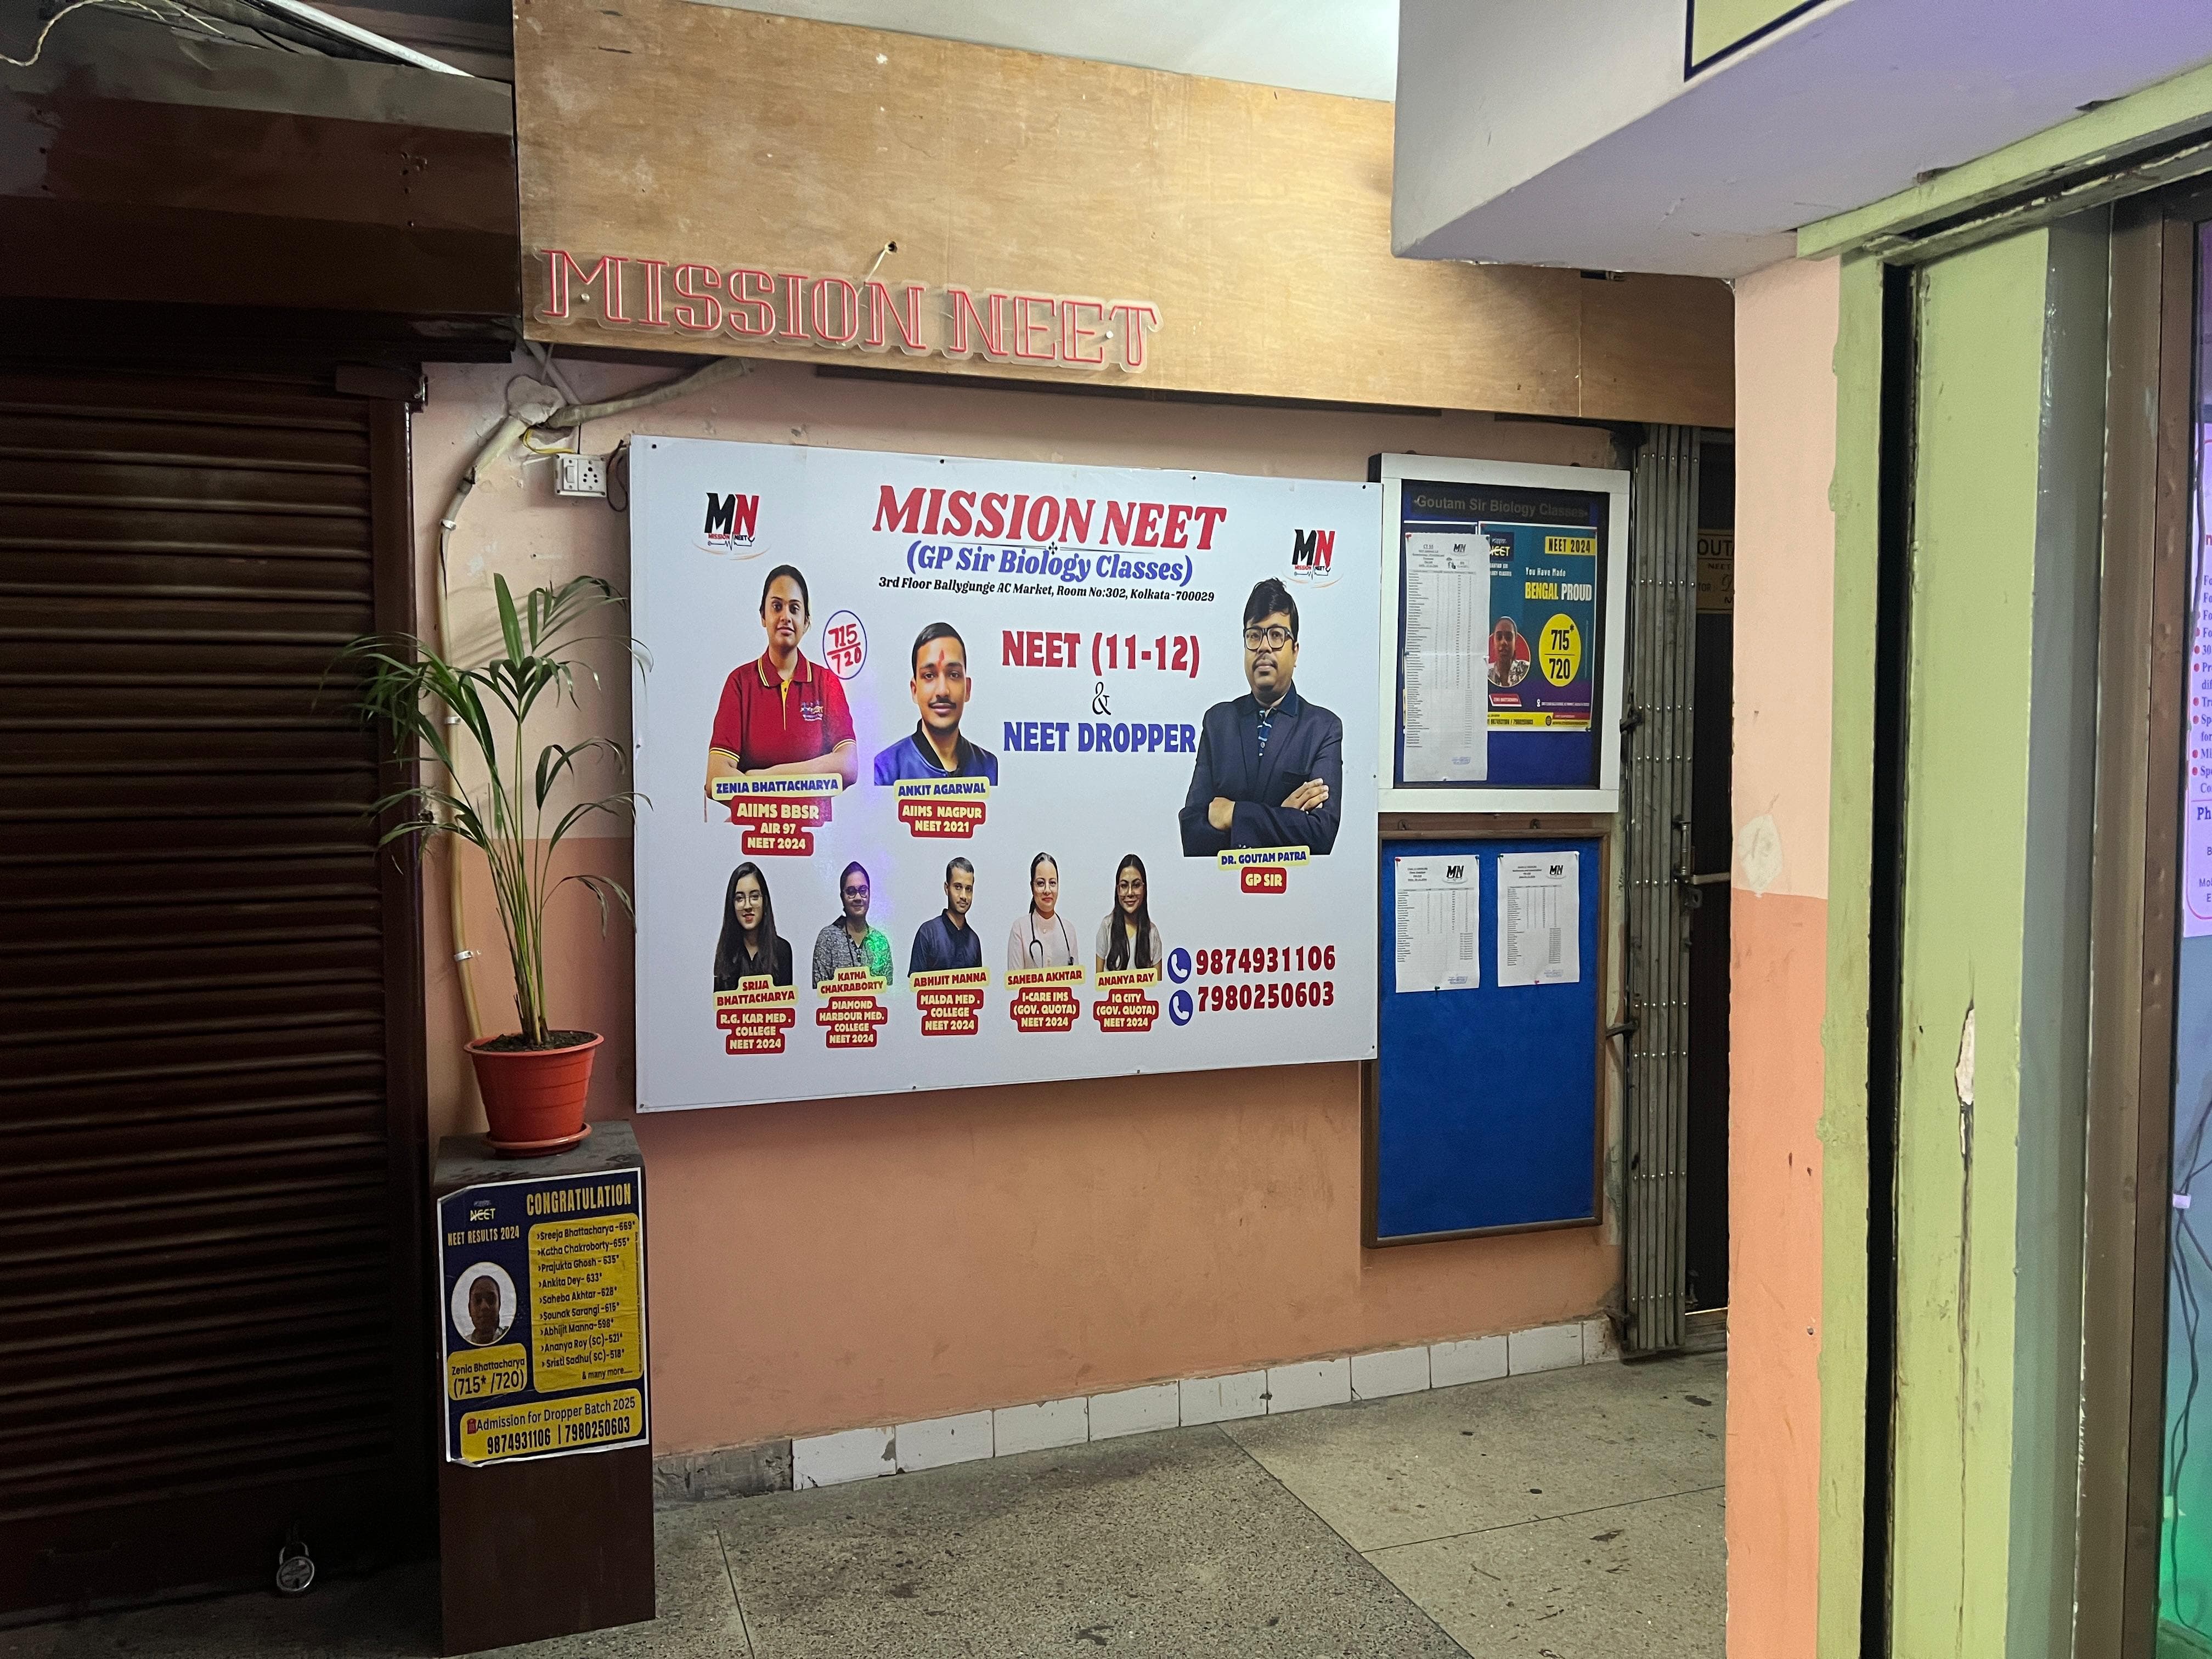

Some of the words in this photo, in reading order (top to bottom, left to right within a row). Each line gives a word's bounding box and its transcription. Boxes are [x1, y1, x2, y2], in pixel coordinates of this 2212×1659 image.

[541, 250, 926, 351] MISSION
[948, 291, 1156, 365] NEET
[1417, 495, 1465, 510] Goutam
[1469, 499, 1486, 511] Sir
[1490, 500, 1536, 517] Biology
[704, 492, 759, 538] MN
[873, 486, 1096, 543] MISSION
[1099, 502, 1227, 551] NEET
[1291, 529, 1335, 567] MN
[1549, 539, 1566, 552] NEET
[1571, 540, 1590, 553] 2024
[1697, 539, 1734, 555] OUT
[907, 540, 953, 574] (GP
[956, 546, 995, 571] Sir
[998, 549, 1091, 582] Biology
[1096, 554, 1192, 586] Classes)
[1537, 568, 1550, 576] Have
[878, 577, 900, 588] 3rd
[901, 578, 932, 589] Floor
[934, 579, 995, 595] Ballygunge
[997, 583, 1011, 593] AC
[1013, 583, 1054, 597] Market,
[1057, 585, 1086, 596] Room
[1088, 586, 1128, 600] No:302,
[1130, 589, 1214, 601] Kolkata-700029
[1525, 582, 1559, 600] BENGAL
[1561, 583, 1592, 601] PROUD
[827, 623, 856, 650] 715
[832, 647, 861, 674] 720
[1002, 630, 1081, 667] NEET
[1092, 633, 1200, 678] (11-12)
[1549, 659, 1570, 679] 720
[1092, 682, 1111, 715] &
[1004, 722, 1069, 751] NEET
[1078, 723, 1196, 753] DROPPER
[716, 780, 750, 794] ZENIA
[752, 778, 838, 793] BHATTACHARYA
[898, 786, 931, 797] ANKIT
[933, 782, 986, 795] AGARWAL
[737, 803, 777, 819] AIIMS
[780, 804, 819, 819] BBSR
[902, 805, 933, 817] AIIMS
[936, 806, 982, 819] NAGPUR
[760, 823, 781, 834] AIR
[782, 823, 795, 834] 97
[915, 821, 940, 832] NEET
[943, 821, 970, 833] 2021
[747, 838, 776, 849] NEET
[777, 838, 805, 850] 2024
[1221, 855, 1237, 865] DR.
[1238, 853, 1276, 864] GOUTAM
[1278, 851, 1306, 861] PATRA
[1446, 866, 1464, 878] MN
[1549, 865, 1563, 875] MN
[1245, 873, 1262, 887] GP
[1263, 874, 1283, 887] SIR
[1196, 945, 1336, 975] 9874931106
[838, 971, 866, 981] KATHA
[913, 975, 949, 987] ABHIJIT
[952, 972, 986, 984] MANNA
[1007, 974, 1043, 985] SAHEBA
[1046, 970, 1082, 983] AKHTAR
[1098, 975, 1135, 986] ANANYA
[1137, 973, 1154, 984] RAY
[742, 980, 769, 991] SRIJA
[821, 981, 883, 994] CHAKRABORTY
[717, 991, 795, 1006] BHATTACHARYA
[921, 995, 952, 1005] MALDA
[1023, 992, 1051, 1002] I-CARE
[1052, 992, 1068, 1002] IMS
[1112, 994, 1122, 1003] IQ
[1124, 993, 1142, 1003] CITY
[1198, 981, 1334, 1012] 7980250603
[832, 1001, 873, 1010] DIAMOND
[931, 1007, 969, 1018] COLLEGE
[1014, 1005, 1040, 1015] (GOV.
[1041, 1005, 1076, 1015] QUOTA)
[1097, 1006, 1120, 1016] (GOV.
[1122, 1005, 1156, 1015] QUOTA)
[720, 1014, 740, 1024] R.G.
[742, 1014, 764, 1023] KAR
[820, 1012, 862, 1021] HARBOUR
[864, 1011, 884, 1020] MED.
[1021, 1017, 1043, 1027] NEET
[1045, 1017, 1068, 1027] 2024
[1103, 1018, 1125, 1028] NEET
[1126, 1018, 1148, 1027] 2024
[736, 1026, 776, 1036] COLLEGE
[834, 1023, 869, 1031] COLLEGE
[925, 1020, 949, 1030] NEET
[950, 1019, 974, 1030] 2024
[730, 1040, 754, 1049] NEET
[757, 1039, 781, 1048] 2024
[830, 1035, 851, 1043] NEET
[853, 1034, 873, 1043] 2024
[527, 1183, 631, 1215] CONGRATULATION
[448, 1233, 465, 1245] NEET
[468, 1229, 498, 1243] RESULTS
[501, 1226, 519, 1239] 2024
[565, 1225, 613, 1238] Bhattacharya
[574, 1258, 596, 1268] Ghosh
[572, 1291, 595, 1301] Akhtar
[572, 1304, 599, 1317] Sarangi
[574, 1339, 587, 1350] Roy
[452, 1365, 472, 1375] Zenia
[474, 1358, 524, 1372] Bhattacharya
[490, 1369, 524, 1393] /720)
[588, 1369, 605, 1379] many
[477, 1413, 524, 1431] Admission
[528, 1411, 541, 1424] for
[544, 1407, 582, 1421] Dropper
[585, 1400, 611, 1415] Batch
[613, 1396, 635, 1410] 2025
[487, 1427, 550, 1454] 9874931106
[566, 1416, 630, 1442] 7980250603
